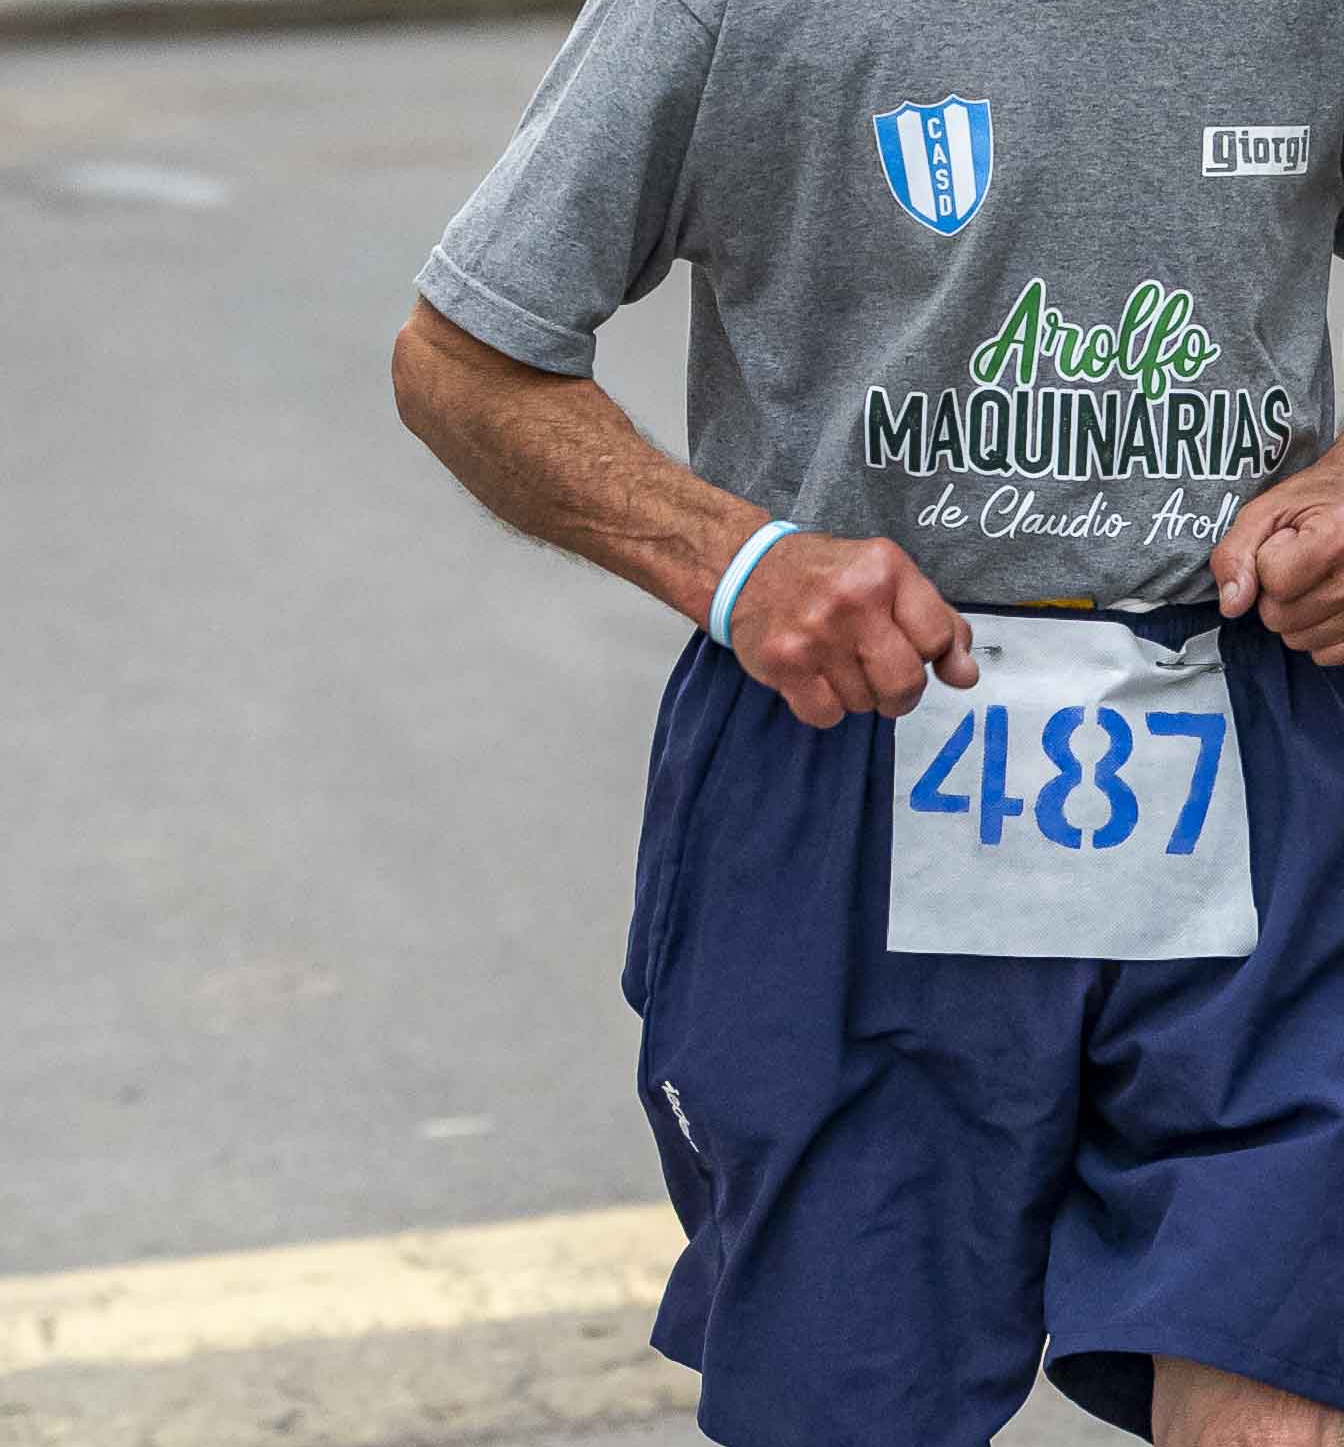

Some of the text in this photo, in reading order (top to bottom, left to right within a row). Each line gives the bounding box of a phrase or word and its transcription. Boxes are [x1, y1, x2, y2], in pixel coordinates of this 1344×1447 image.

[927, 116, 953, 217] CASD
[1205, 129, 1307, 173] giorgi
[970, 278, 1220, 401] Arolfo
[864, 385, 1292, 481] MAQUINARIAS
[917, 483, 969, 529] de
[980, 485, 1132, 539] Claudio
[909, 703, 1226, 856] 487
